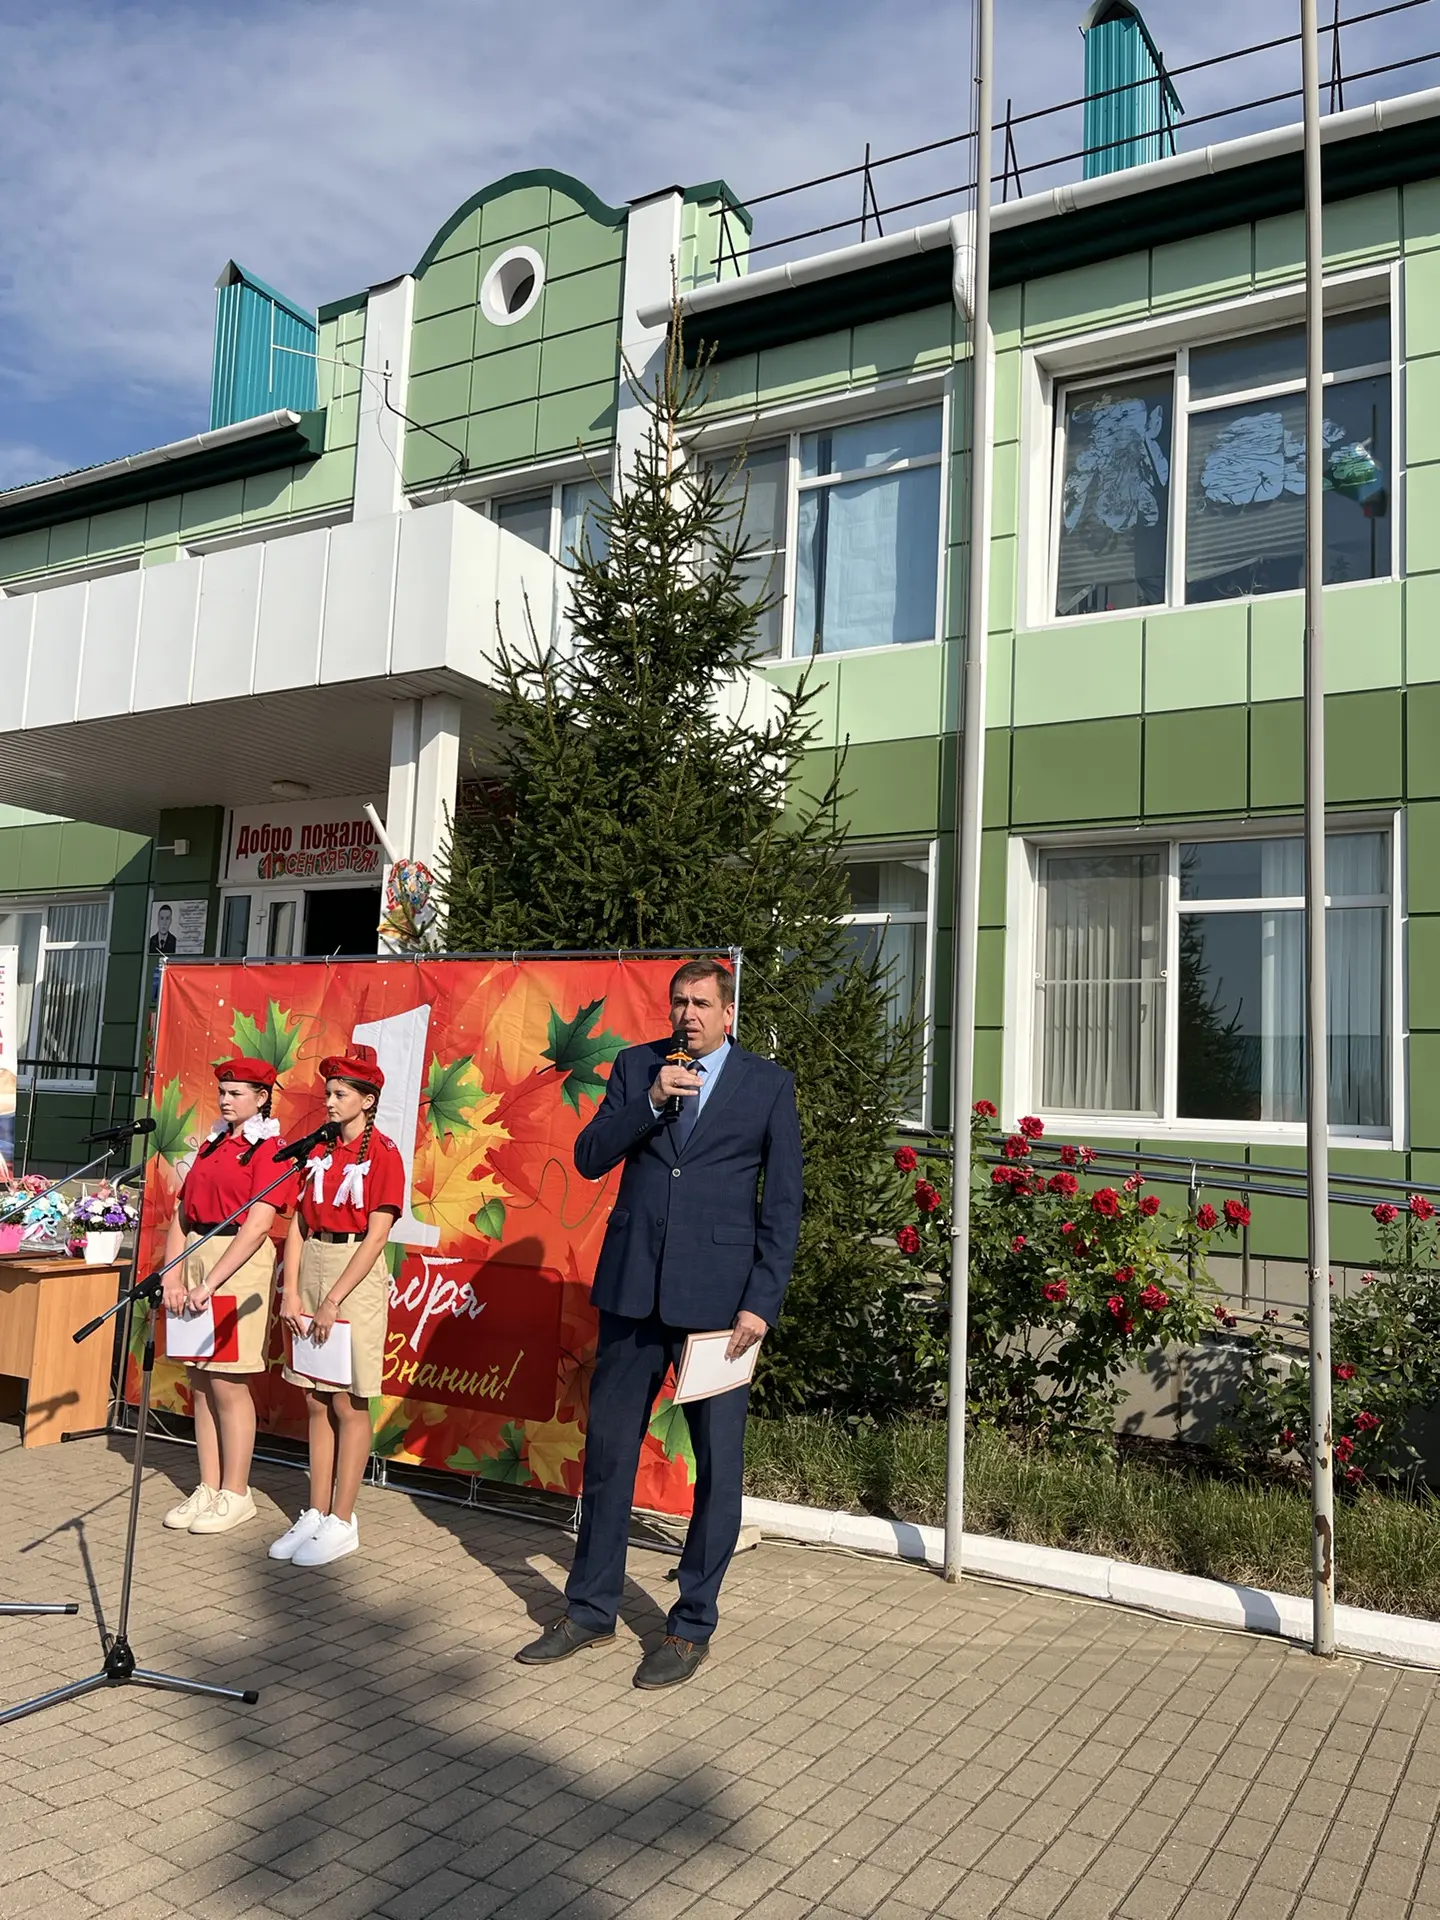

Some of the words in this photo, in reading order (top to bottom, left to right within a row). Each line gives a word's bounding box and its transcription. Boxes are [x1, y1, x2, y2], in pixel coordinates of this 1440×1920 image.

[236, 823, 292, 860] Добро
[260, 852, 274, 880] 1
[285, 848, 379, 875] СЕНТЯБРЯ!
[352, 1004, 440, 1249] 1
[381, 1331, 524, 1401] Знаний!
